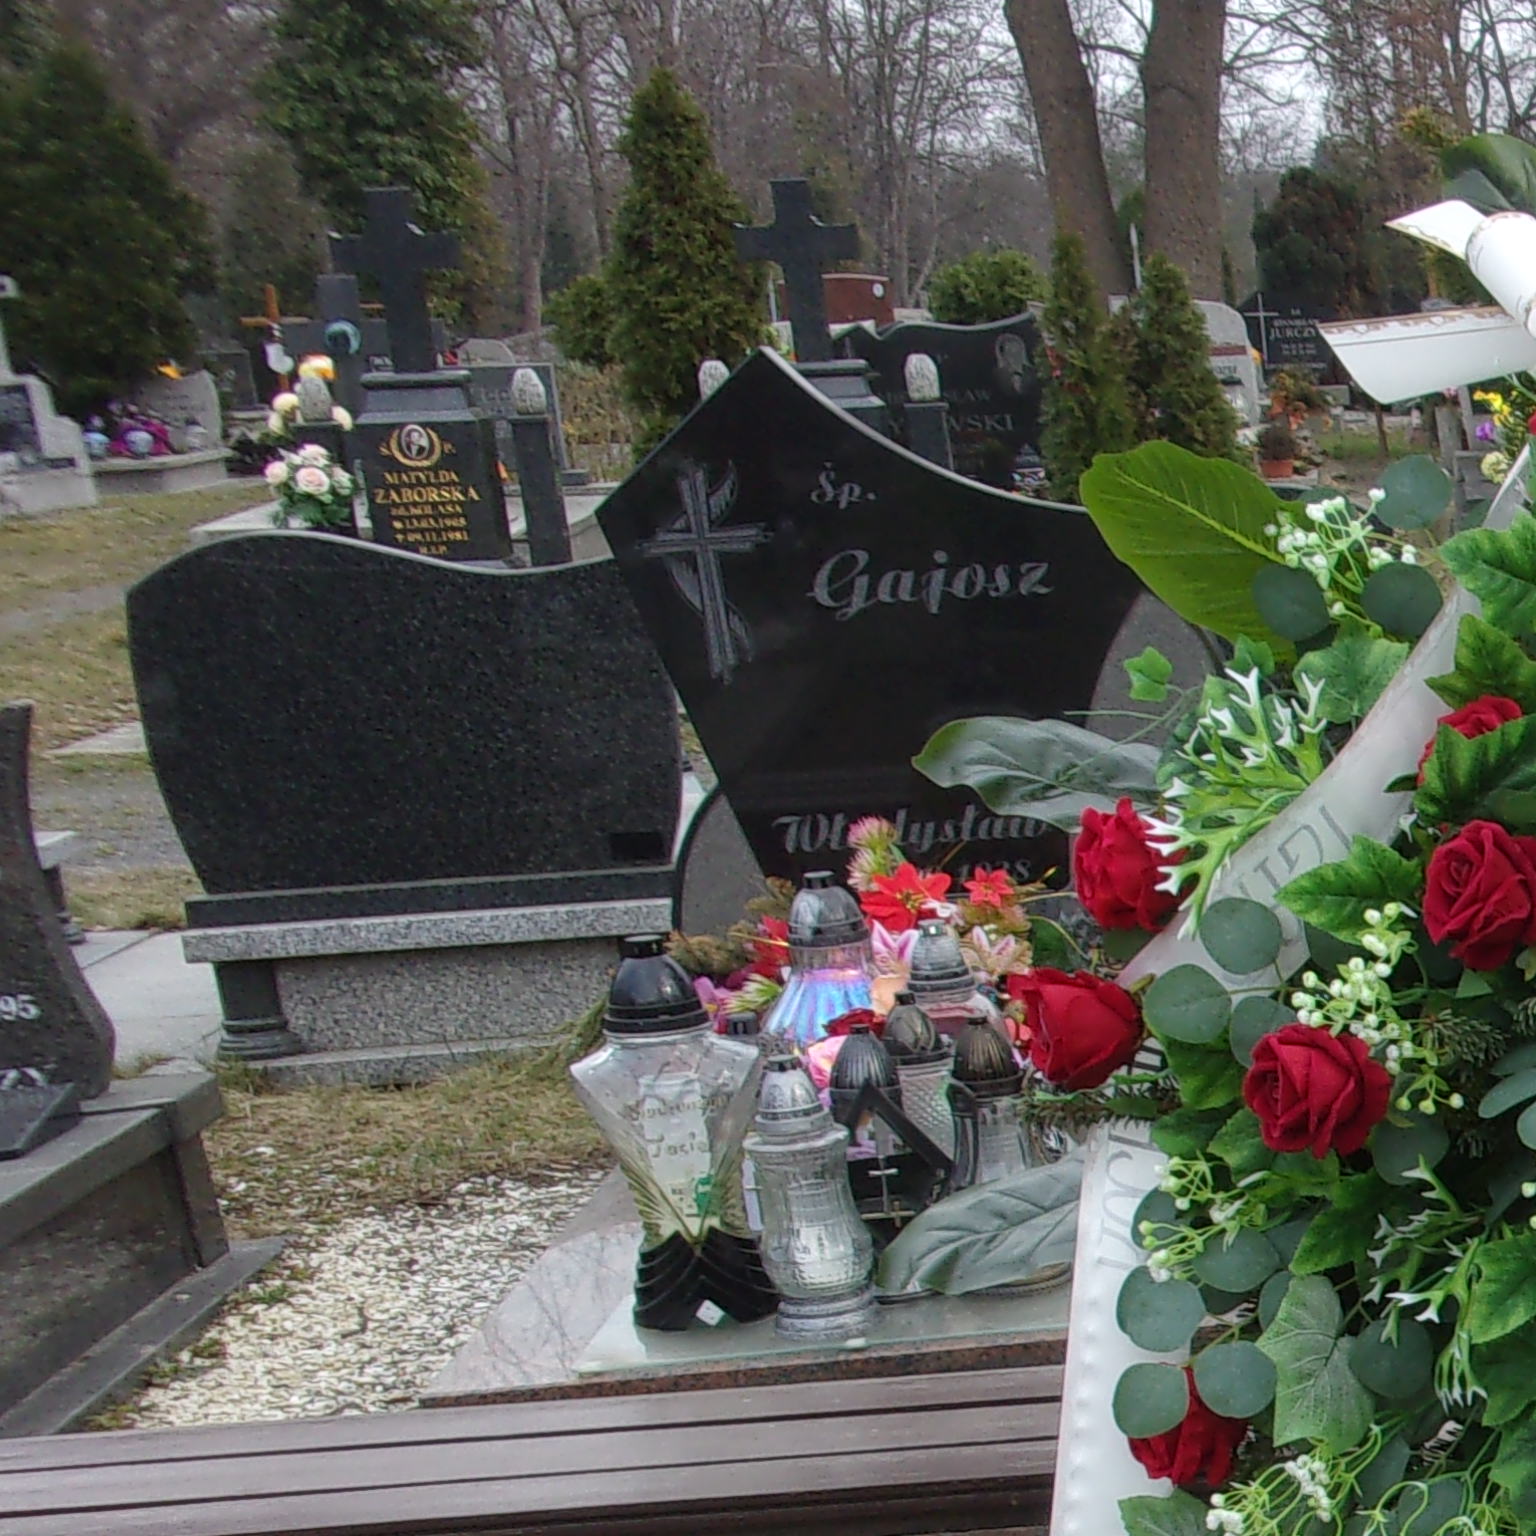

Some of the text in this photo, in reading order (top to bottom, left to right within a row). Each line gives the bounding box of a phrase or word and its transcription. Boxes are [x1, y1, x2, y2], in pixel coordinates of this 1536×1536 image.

[1269, 327, 1317, 340] JURCZY
[383, 470, 460, 484] MATYLDA
[810, 461, 877, 509] Śp.
[805, 549, 1056, 621] Gajosz
[771, 803, 1048, 854] Włysław
